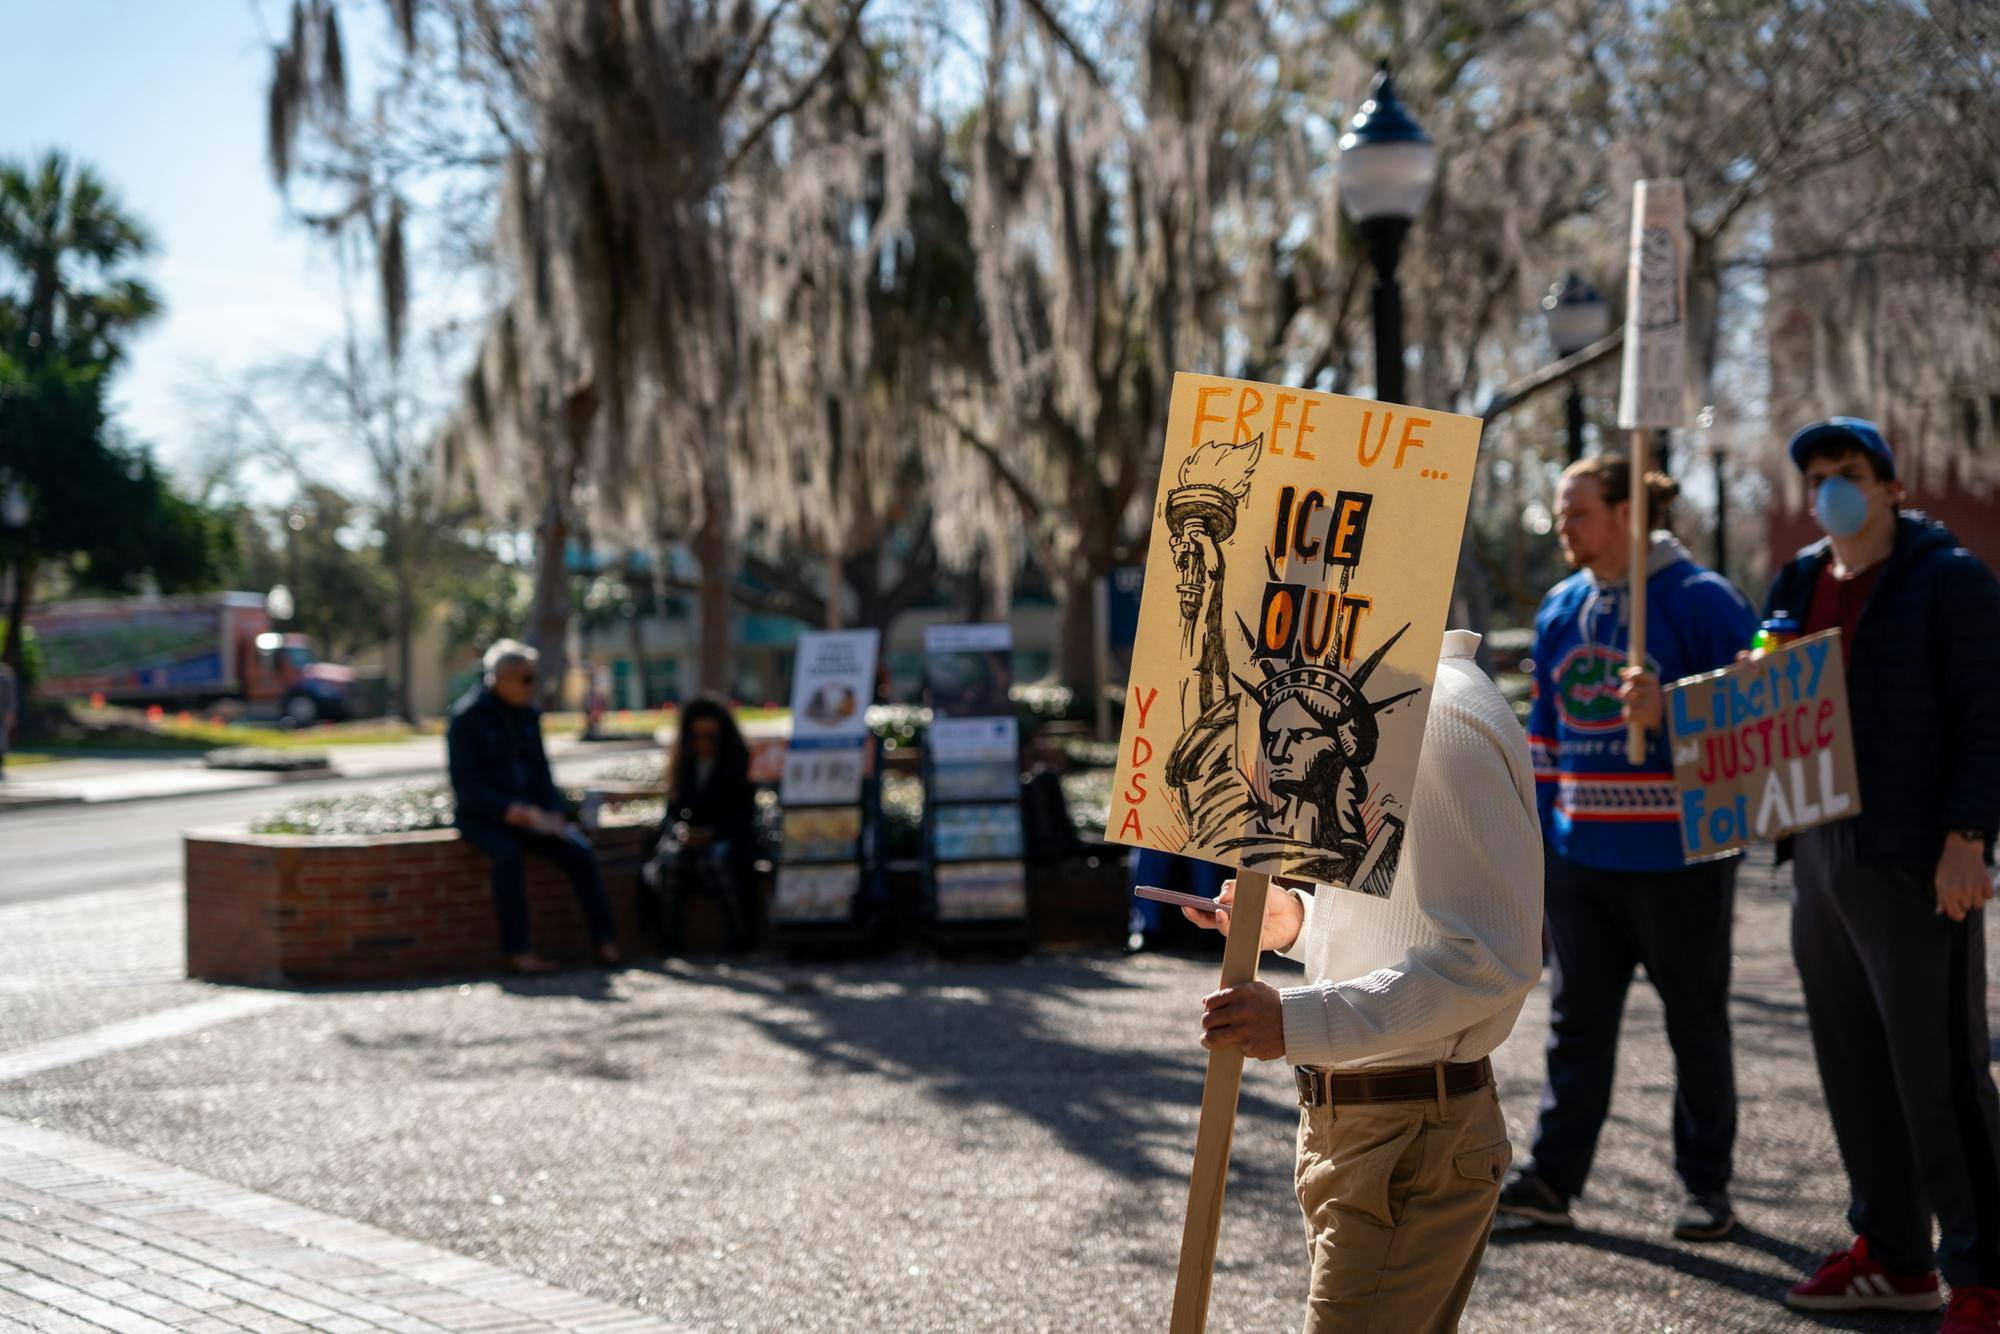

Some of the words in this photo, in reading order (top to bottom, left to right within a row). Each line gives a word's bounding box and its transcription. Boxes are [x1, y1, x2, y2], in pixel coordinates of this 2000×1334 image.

[1191, 386, 1320, 461] FREE
[1271, 485, 1374, 567] ICE
[1257, 581, 1374, 663] OUT
[1671, 638, 1831, 736] Liberty
[1119, 686, 1159, 841] YDSA
[1753, 749, 1850, 836] ALL
